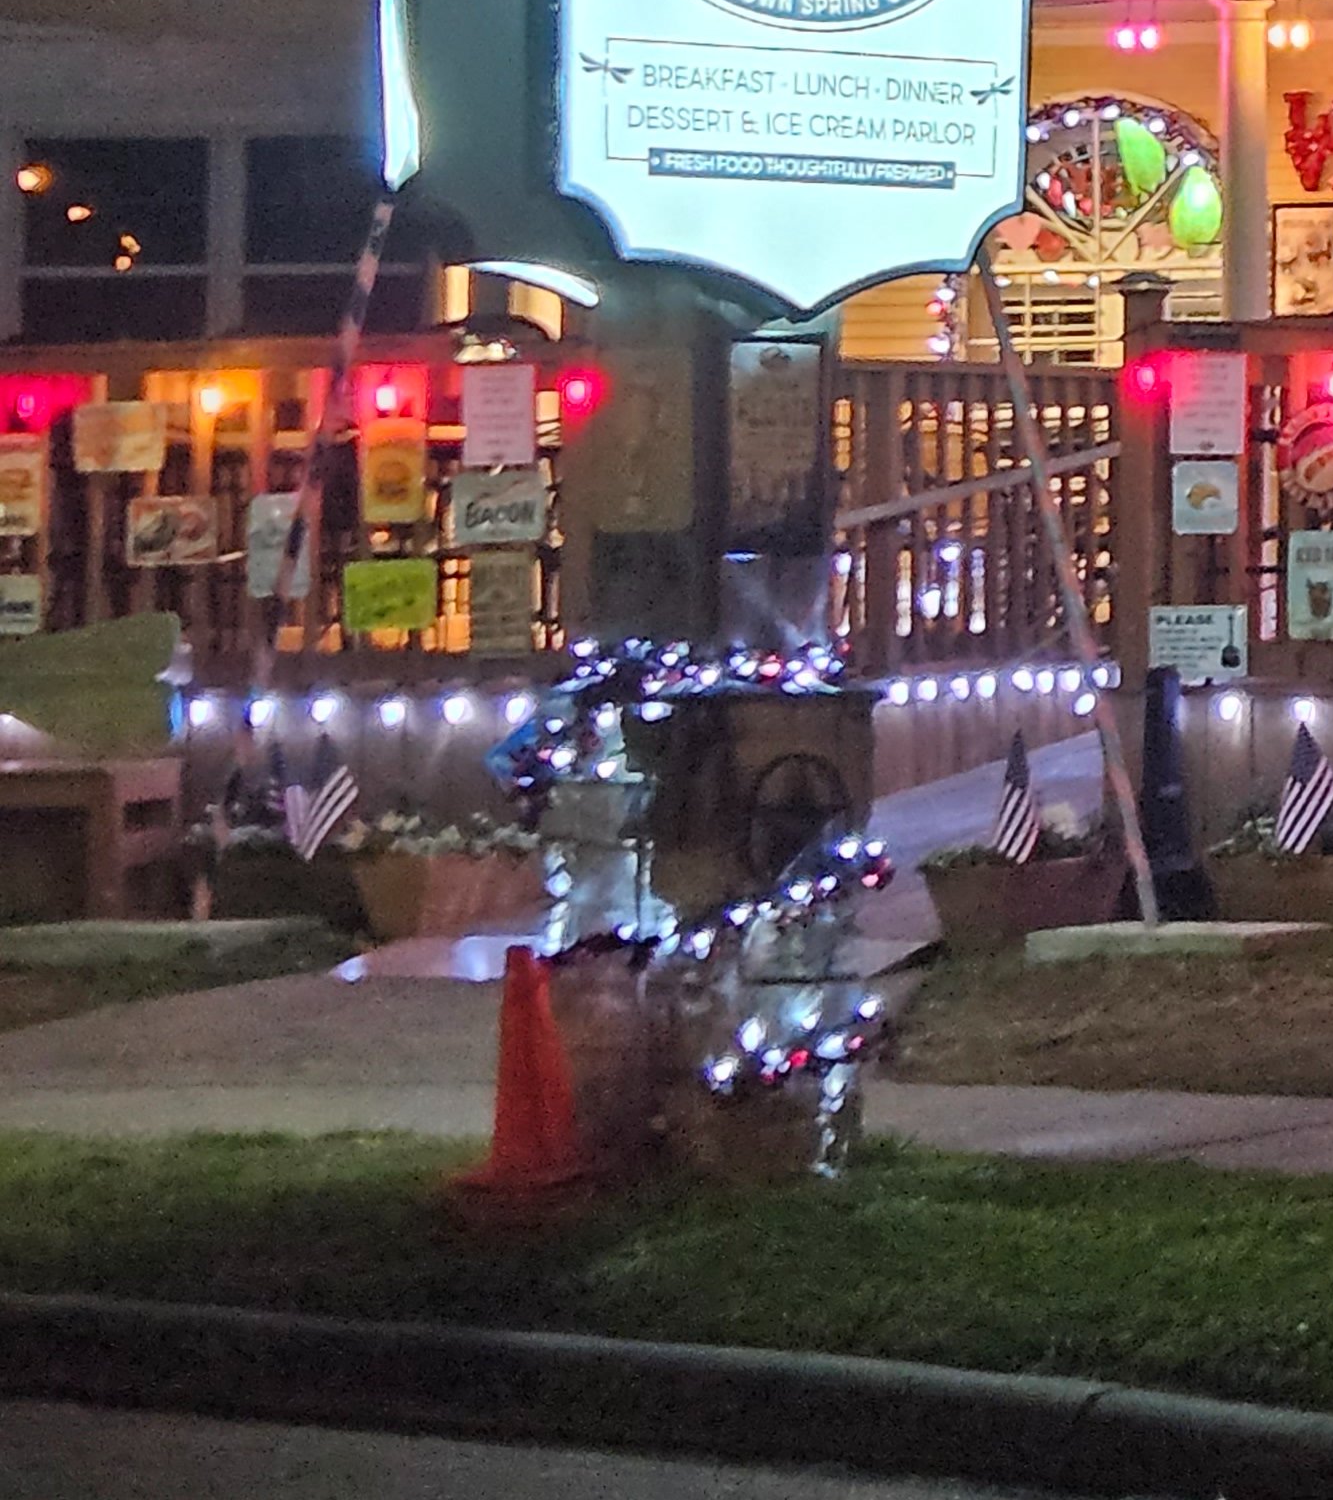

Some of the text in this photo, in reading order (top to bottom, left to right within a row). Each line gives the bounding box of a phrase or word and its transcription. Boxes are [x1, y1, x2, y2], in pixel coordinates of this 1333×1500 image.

[643, 64, 963, 105] BREAKFAST LUNCH DINNER
[627, 104, 975, 145] DESSERT & ICE CREAM PARLOR
[665, 152, 945, 182] FRESH FOOD THOUGHTFULLY PREPARED
